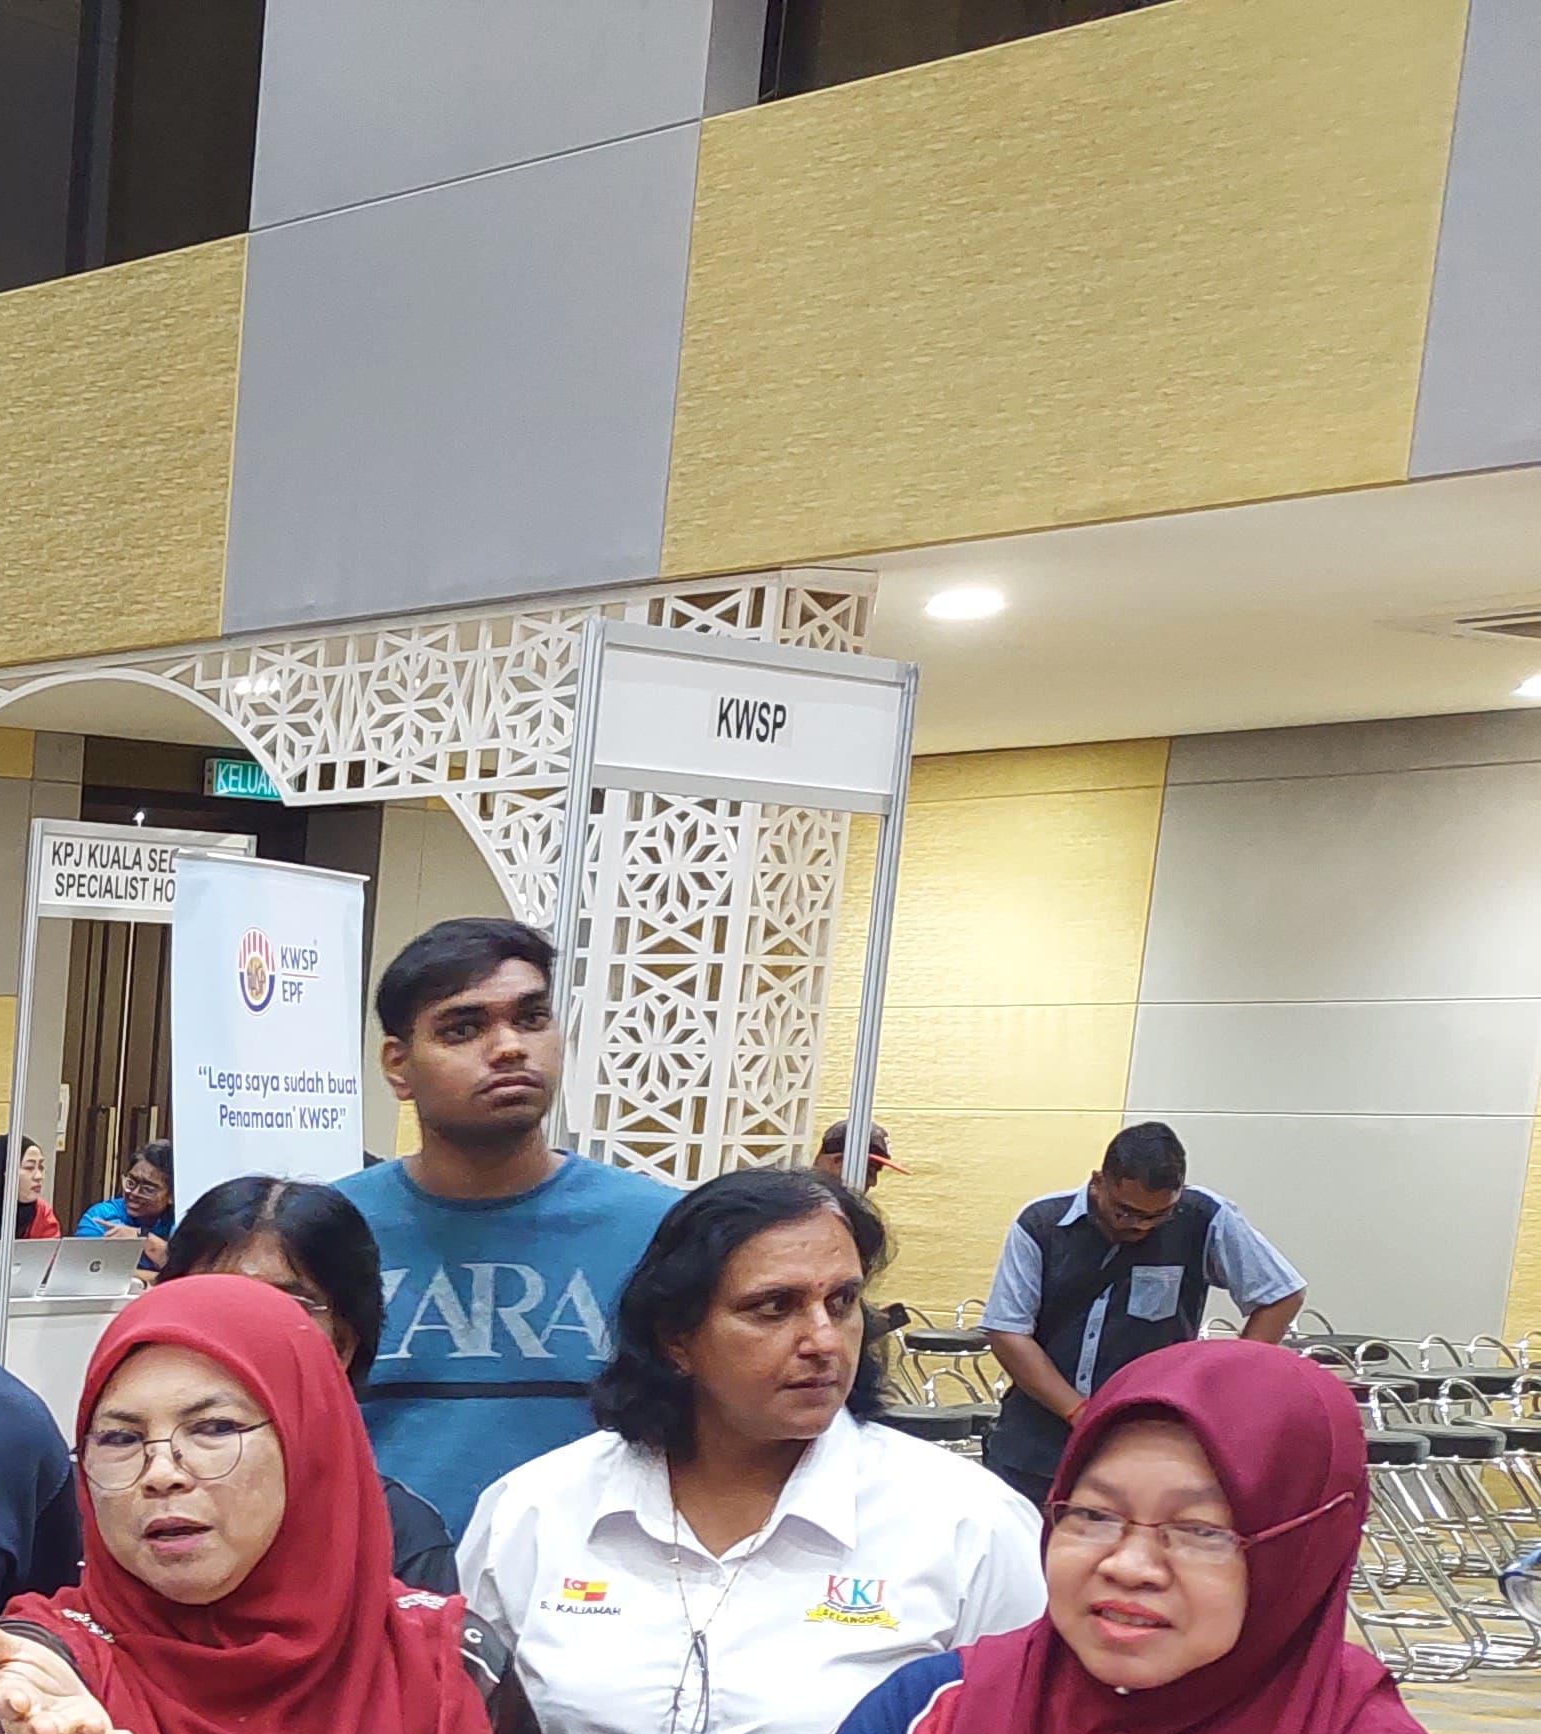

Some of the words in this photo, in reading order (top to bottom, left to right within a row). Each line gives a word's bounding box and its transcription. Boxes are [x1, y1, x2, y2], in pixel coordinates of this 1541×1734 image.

[716, 697, 788, 744] KWSP
[51, 841, 84, 867] KPJ
[86, 843, 143, 871] KUALA
[147, 848, 178, 874] SEL
[54, 873, 150, 901] SPECIALIST
[153, 879, 176, 903] HO
[280, 944, 319, 973] KWSP
[281, 980, 304, 1004] EPF
[244, 1072, 280, 1098] saya
[283, 1068, 325, 1095] sudah
[327, 1071, 358, 1096] buat
[823, 1574, 888, 1606] KKI
